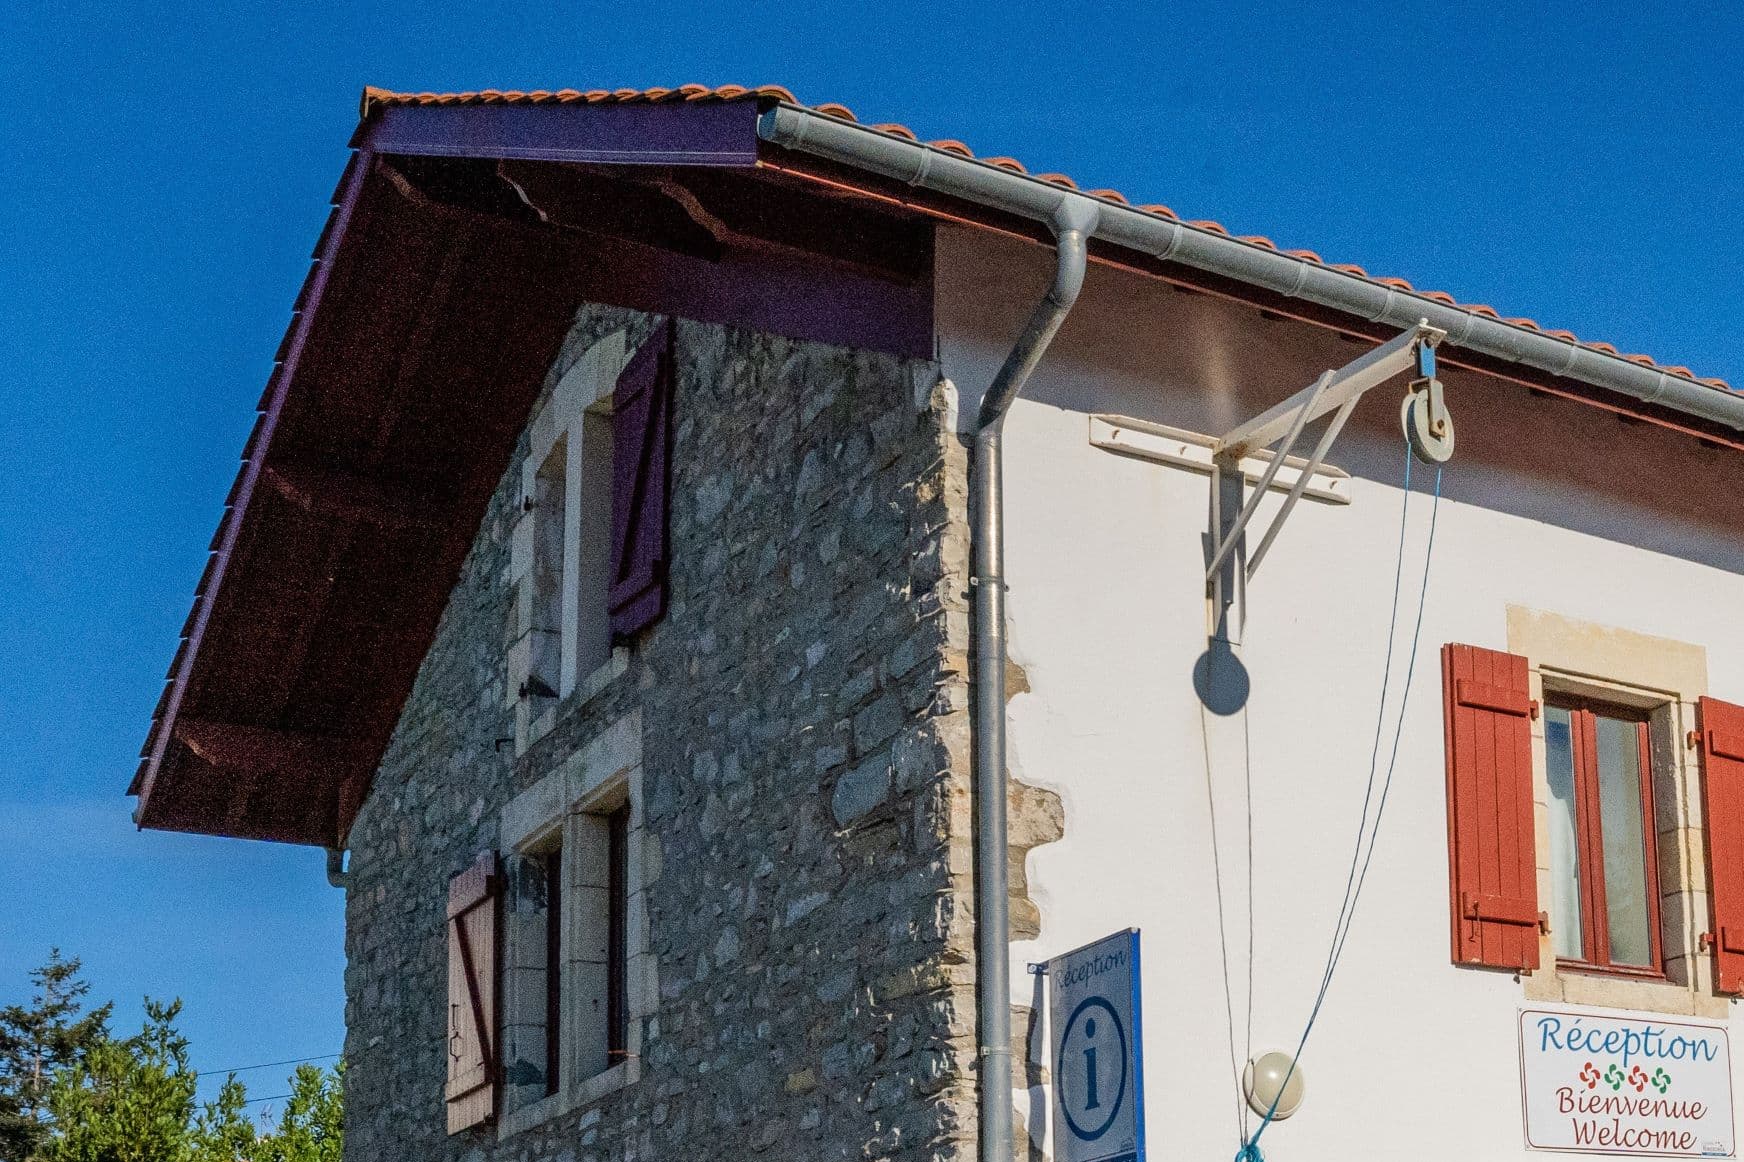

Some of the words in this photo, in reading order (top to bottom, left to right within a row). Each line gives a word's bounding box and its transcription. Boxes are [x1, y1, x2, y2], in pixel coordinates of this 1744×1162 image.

[1054, 949, 1128, 990] Réception
[1537, 1017, 1718, 1068] Réception
[1555, 1086, 1708, 1120] Bienvenue
[1572, 1118, 1697, 1150] Welcome
